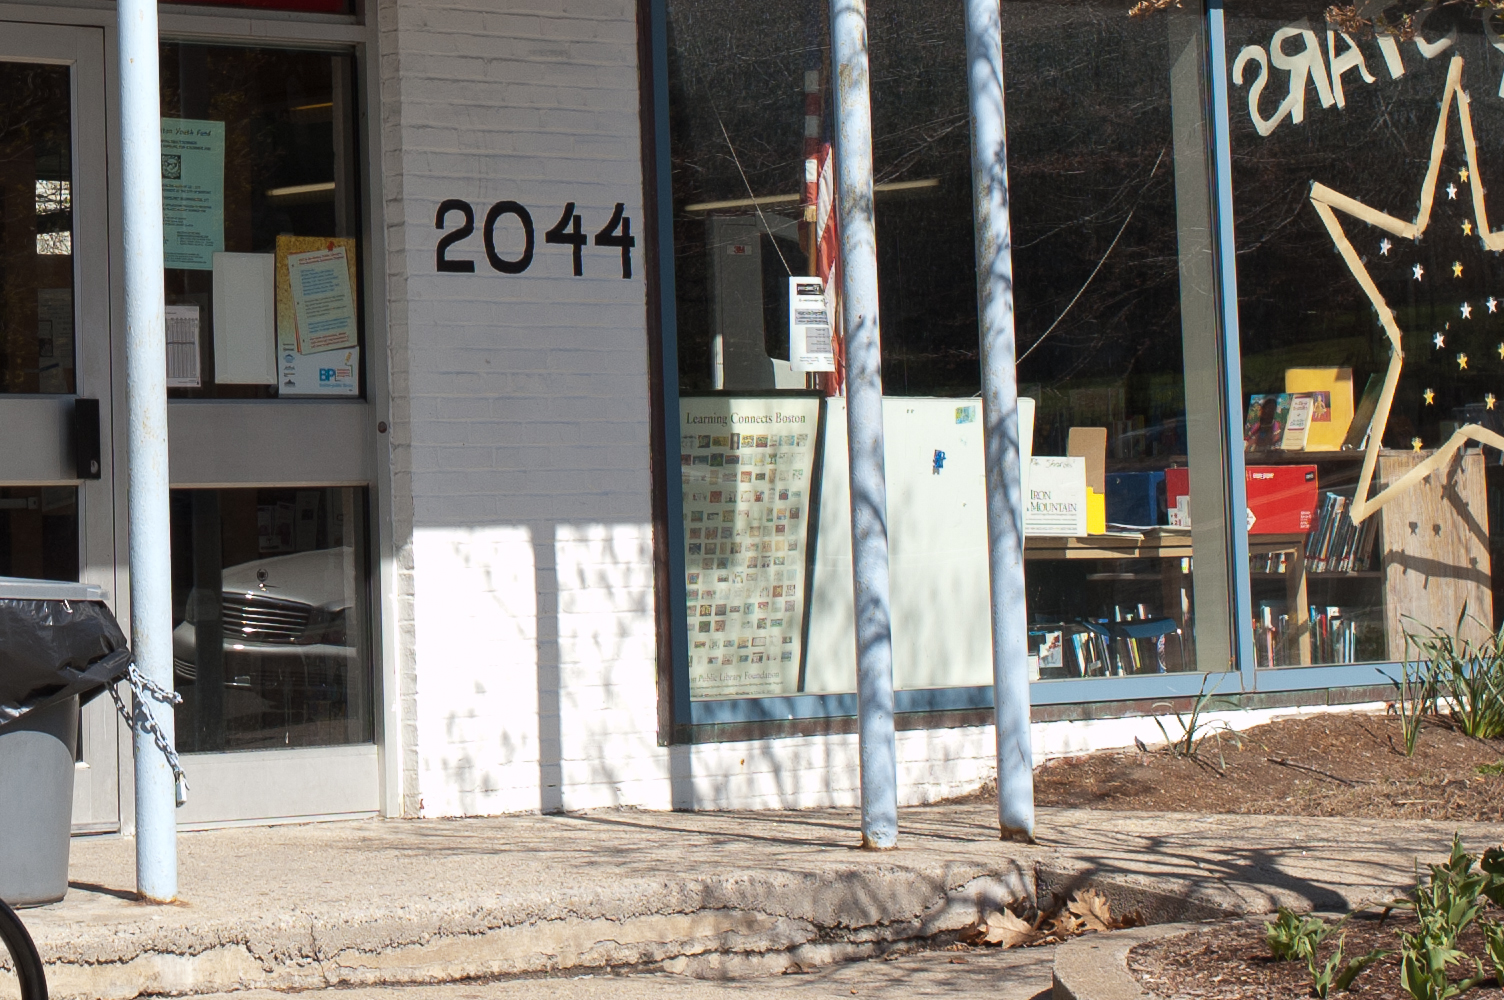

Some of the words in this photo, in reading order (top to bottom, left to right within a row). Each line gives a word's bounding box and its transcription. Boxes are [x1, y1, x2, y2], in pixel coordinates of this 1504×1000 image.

[435, 198, 636, 280] 2044
[686, 411, 728, 427] Learning
[730, 411, 773, 425] Connects
[775, 411, 806, 424] Boston
[1030, 489, 1052, 500] IRON
[1030, 501, 1078, 512] MOUNTAIN
[719, 672, 742, 682] Library
